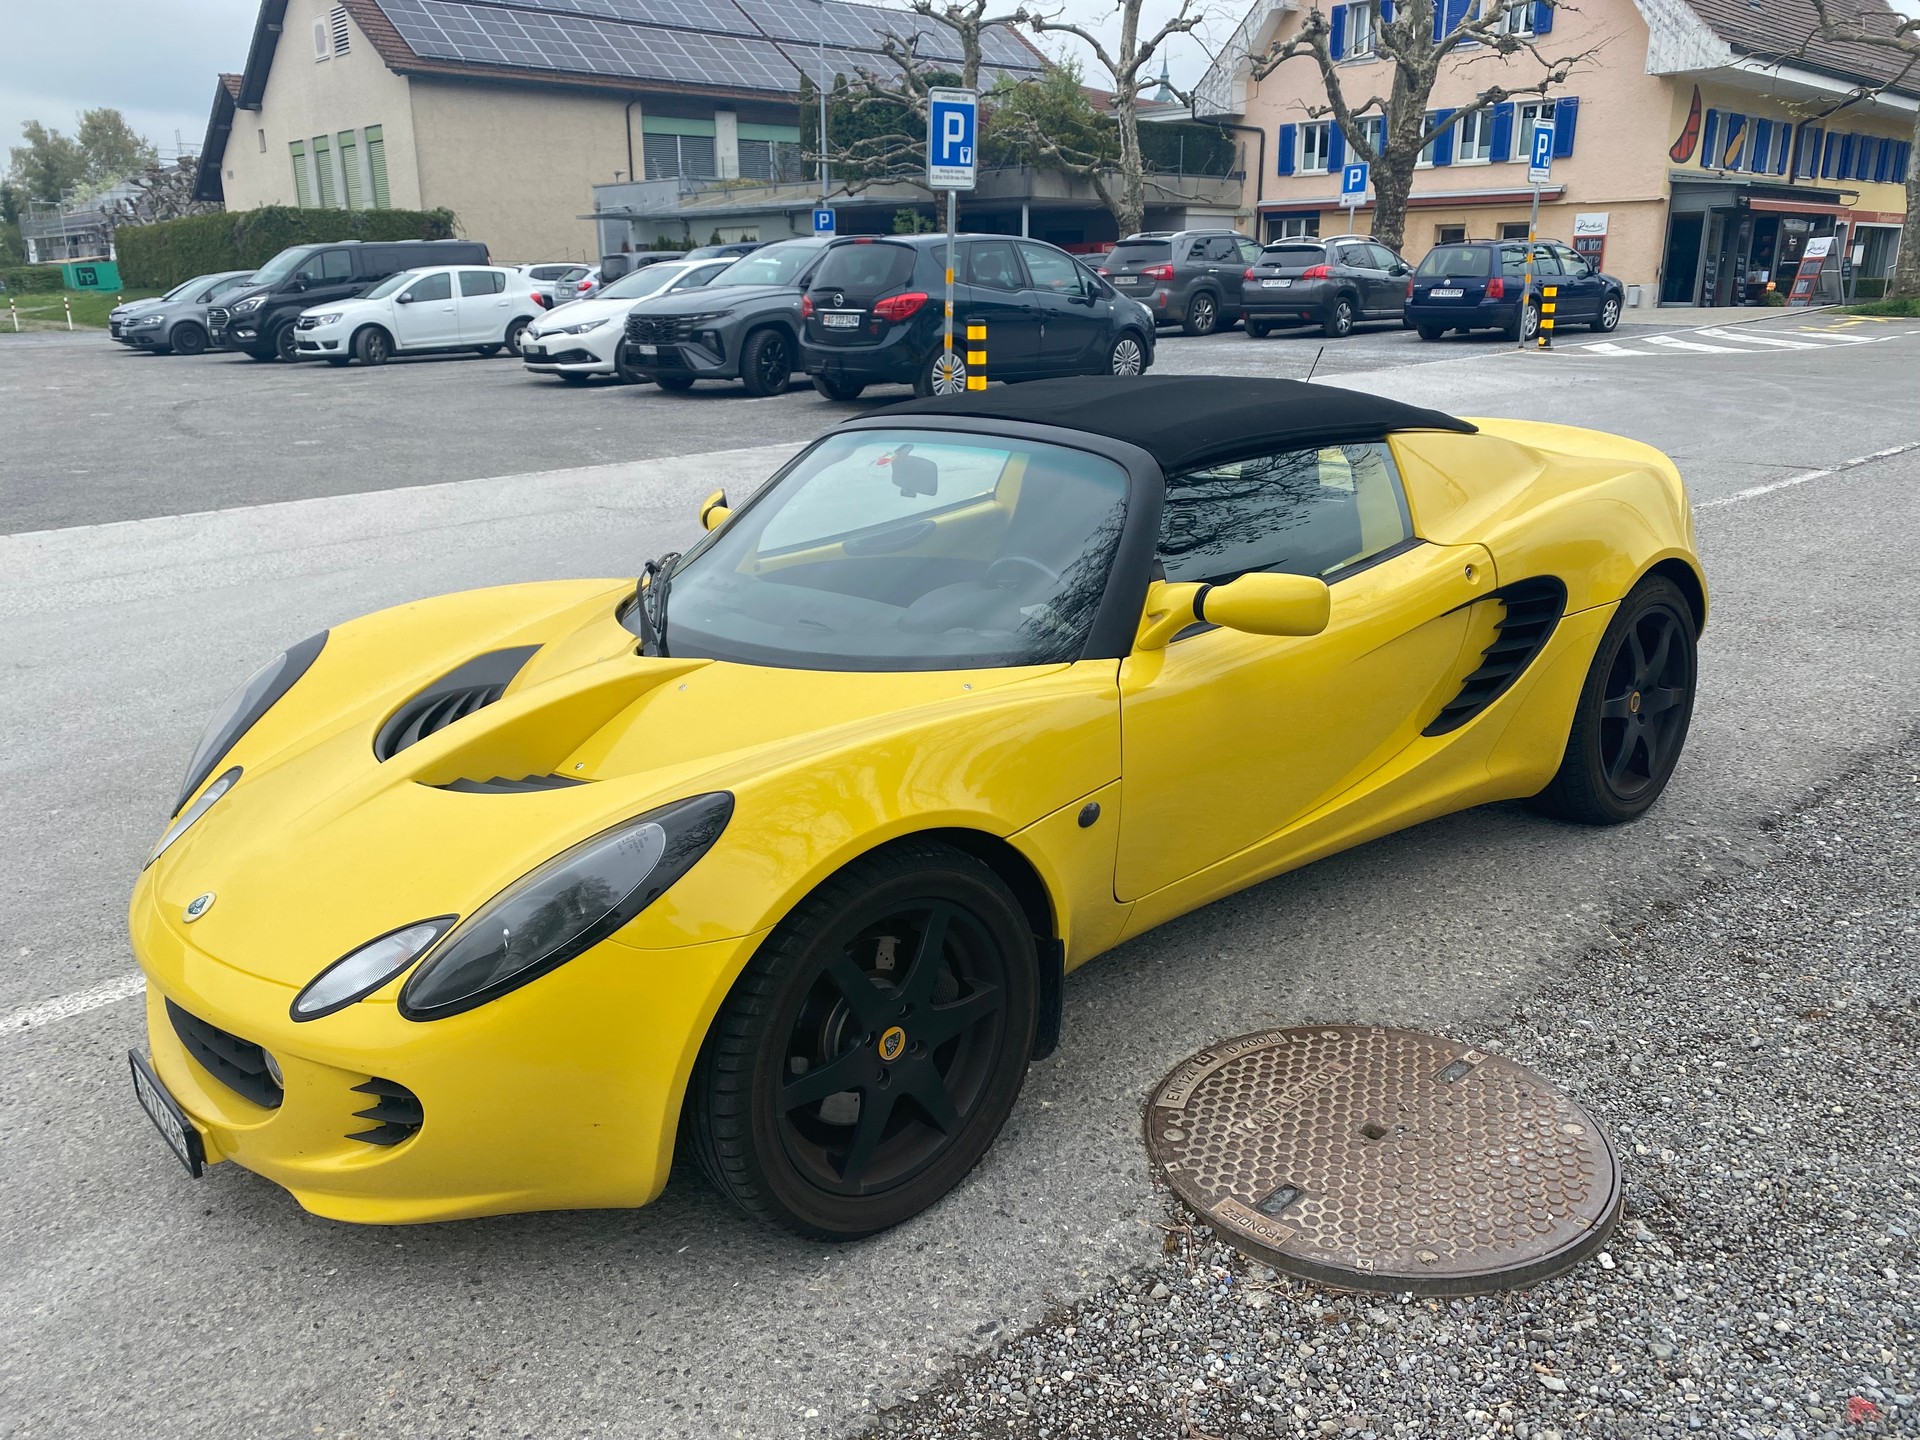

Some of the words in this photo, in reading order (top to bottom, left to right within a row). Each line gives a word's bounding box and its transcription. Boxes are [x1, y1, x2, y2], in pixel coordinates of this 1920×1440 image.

[943, 111, 965, 159] P
[1536, 133, 1548, 164] P
[1349, 169, 1362, 190] P
[819, 213, 829, 229] P
[1166, 1085, 1184, 1102] EN
[1182, 1068, 1199, 1085] 124
[1225, 1046, 1239, 1055] D
[1240, 1037, 1267, 1050] 400
[1238, 1063, 1345, 1136] KANALISATION
[1221, 1207, 1278, 1239] RONDEZ
